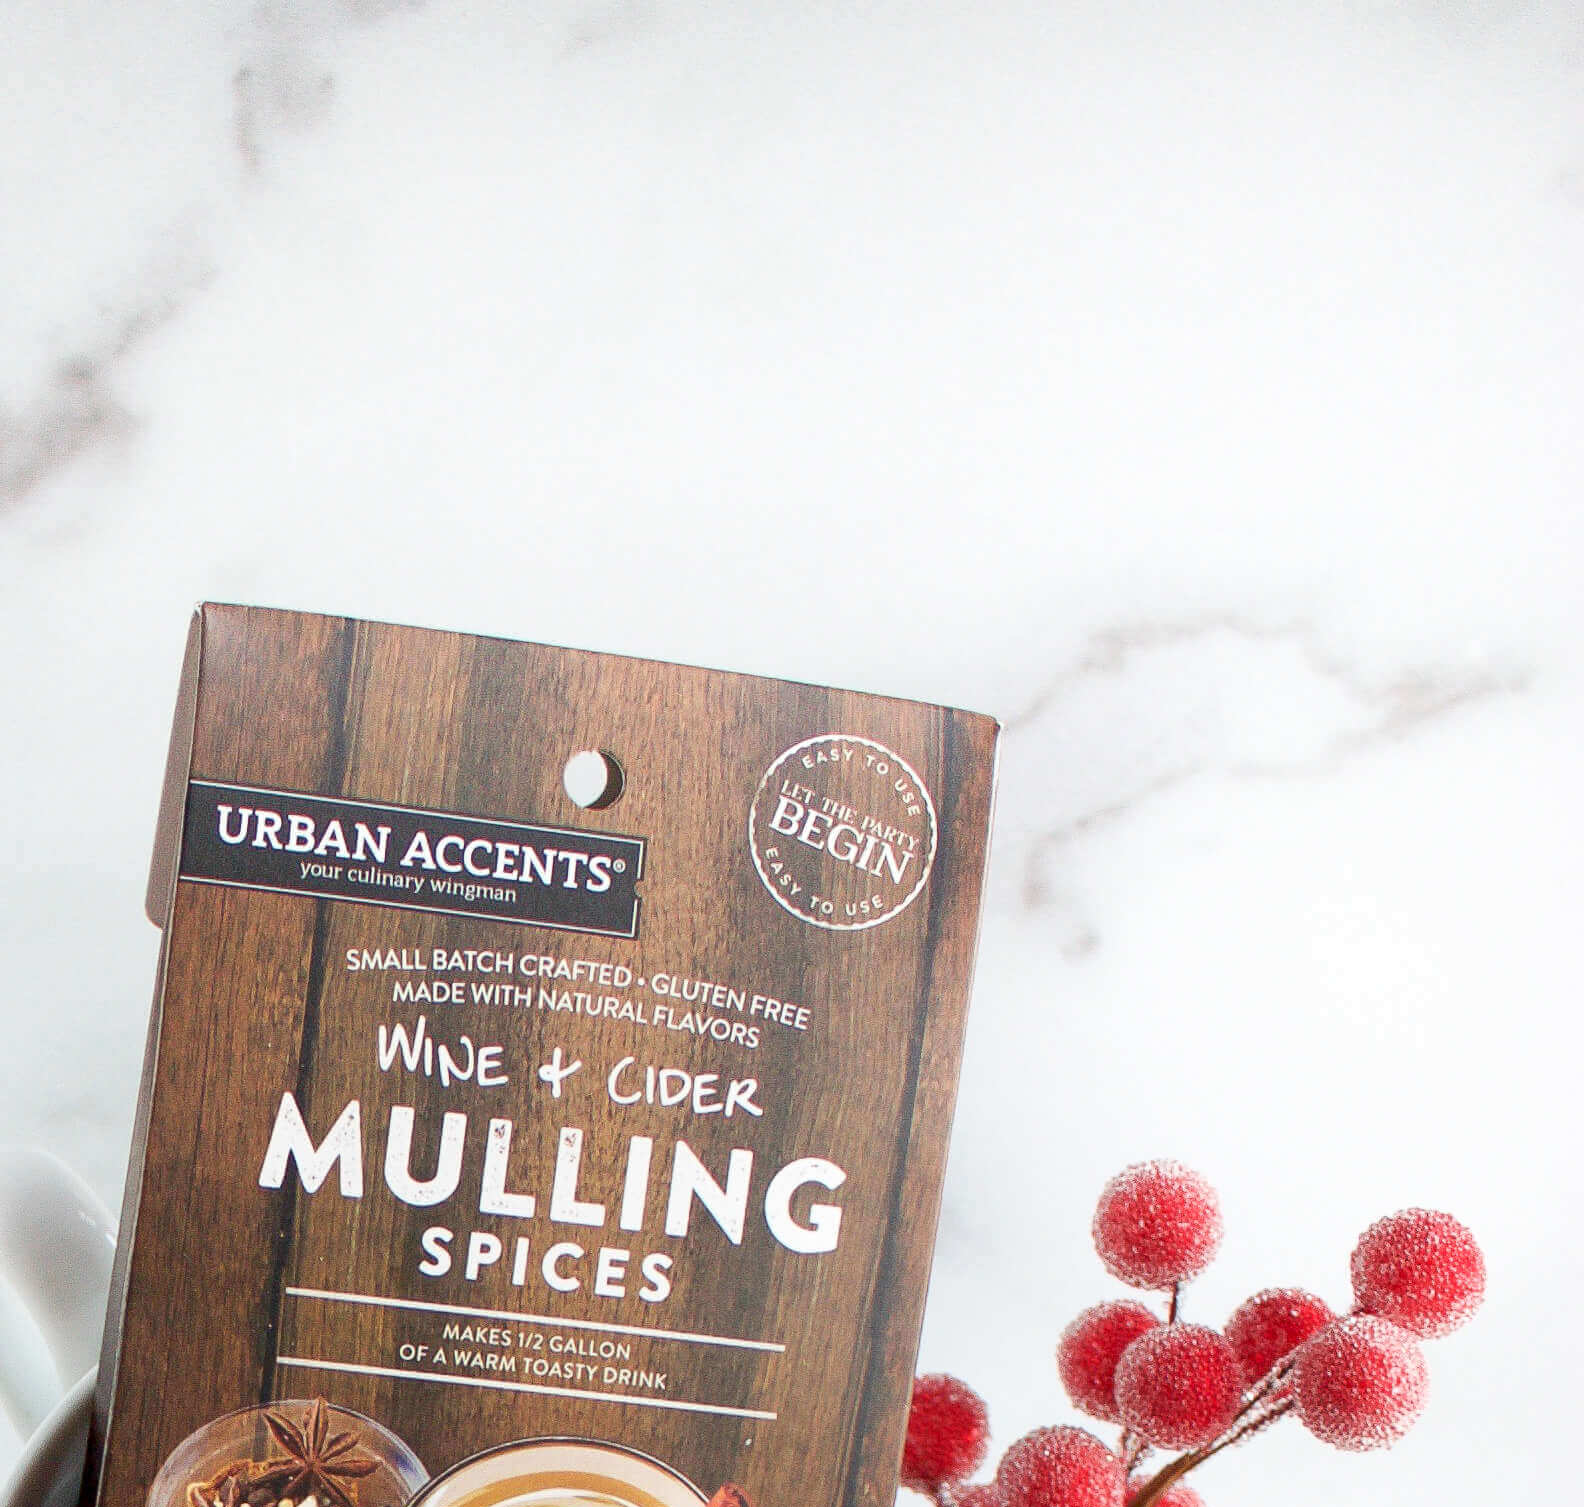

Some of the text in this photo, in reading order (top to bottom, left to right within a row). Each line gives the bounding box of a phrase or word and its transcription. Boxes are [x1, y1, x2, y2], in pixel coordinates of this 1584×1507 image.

[781, 780, 920, 851] LET THE PARTY
[802, 749, 921, 817] EASY TO USE
[216, 804, 391, 863] URBAN
[769, 795, 914, 885] BEGIN
[300, 860, 516, 903] your culinary wingman
[766, 847, 884, 916] EASY TO USE
[346, 948, 811, 1031] SMALL BATCH CRAFTED GLUTEN FREE
[392, 982, 759, 1049] MADE WITH NATURAL FLAVORS
[377, 1014, 509, 1088] WINE
[607, 1055, 764, 1118] CIDER
[258, 1091, 847, 1255] MULLING
[418, 1226, 674, 1302] SPICES
[399, 1343, 667, 1391] OF A WARM TOASTY DRINK
[442, 1323, 631, 1361] MAKES 1/2 GALLON
